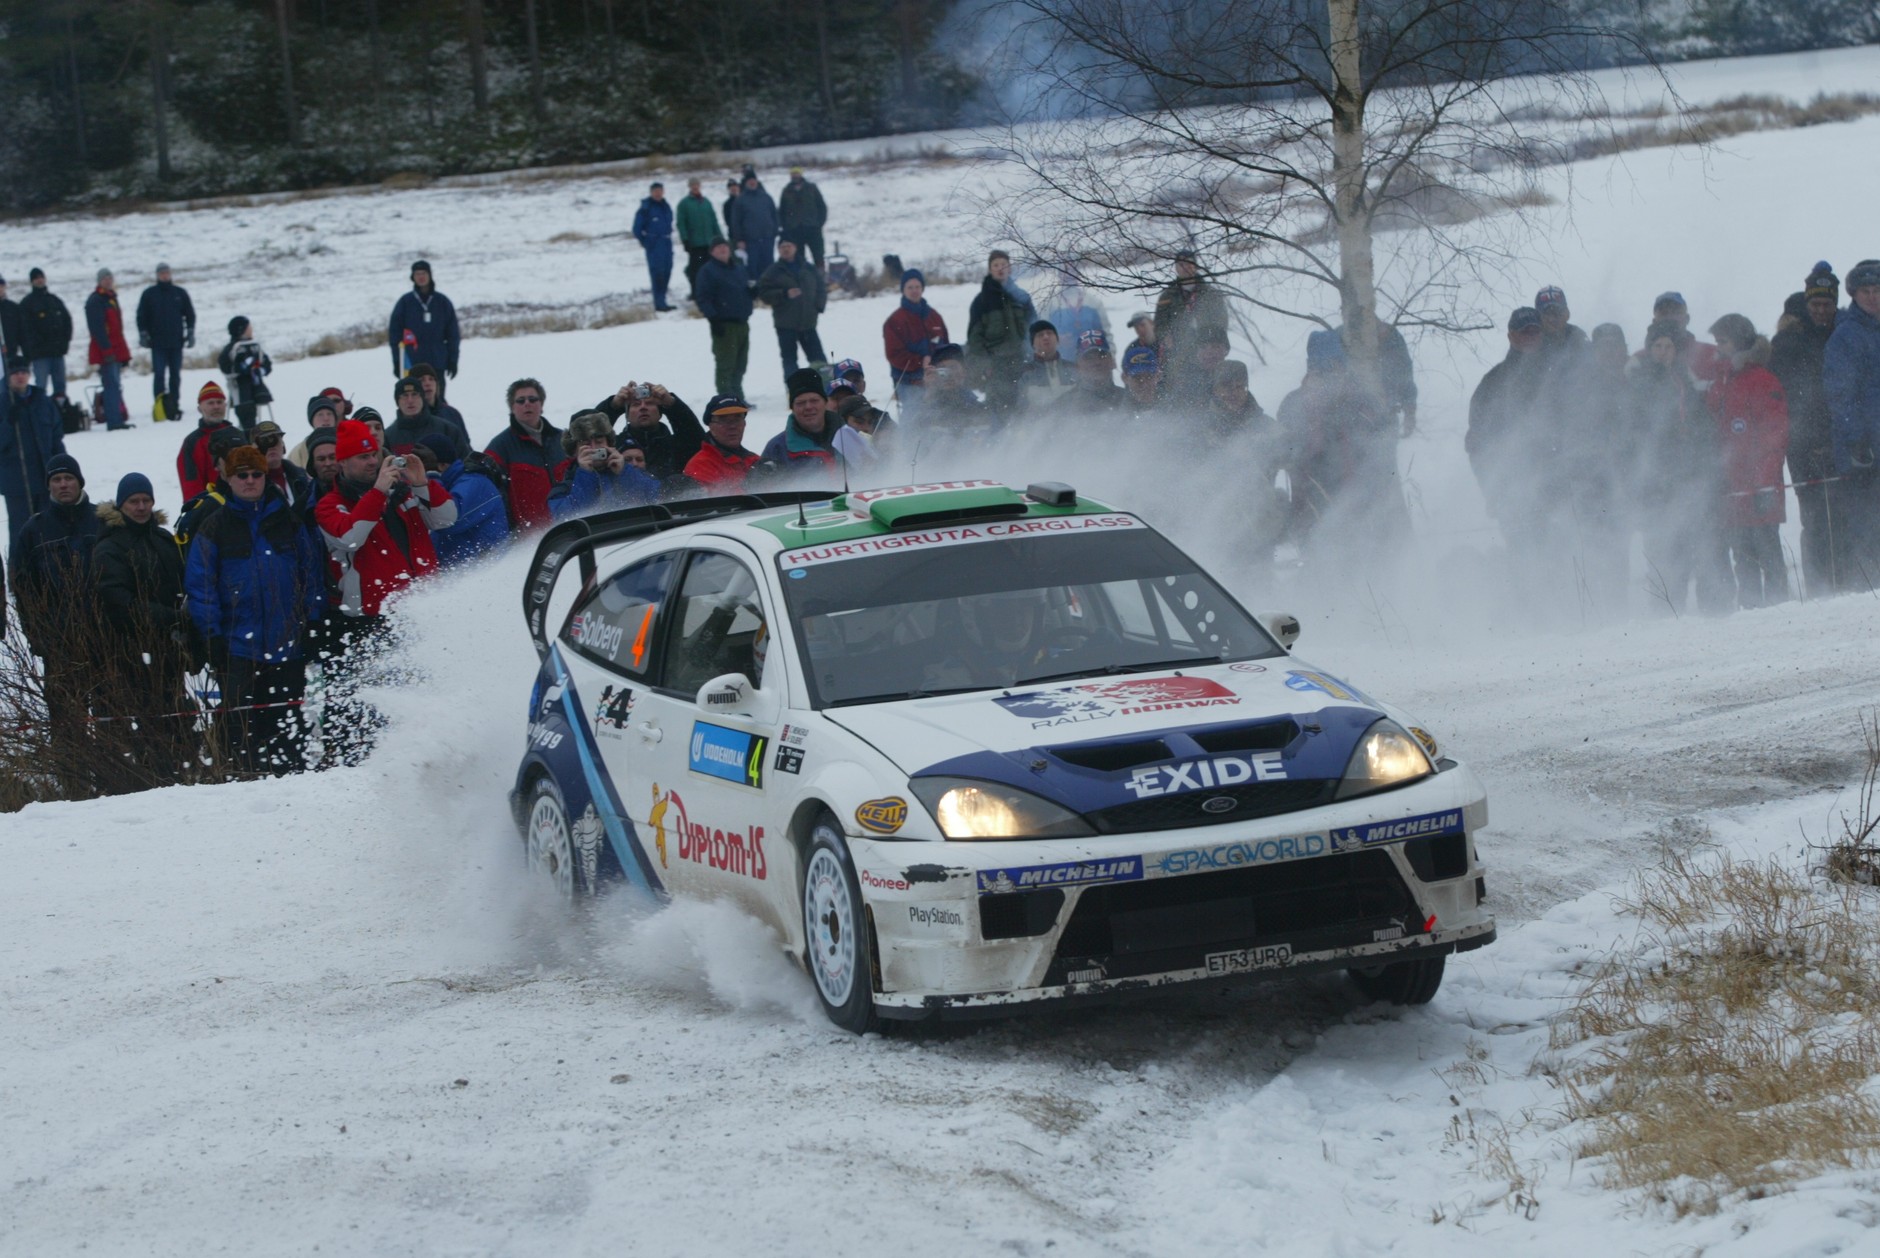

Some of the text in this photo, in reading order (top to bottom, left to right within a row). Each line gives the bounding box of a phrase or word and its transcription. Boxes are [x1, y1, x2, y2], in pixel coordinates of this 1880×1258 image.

[787, 516, 1134, 564] HURTIGRUTA CARGLASS
[578, 611, 624, 661] Solberg
[631, 604, 655, 668] 4
[707, 692, 737, 704] PUMA
[1031, 709, 1117, 730] RALLY
[703, 742, 746, 768] UDDEHOLM
[748, 738, 763, 788] 4
[1124, 751, 1288, 799] EXIDE
[860, 805, 907, 826] HELLA
[1366, 813, 1459, 841] MICHELIN
[1166, 834, 1325, 873] SPACEWORLD
[861, 869, 910, 891] Pioneer
[1019, 861, 1136, 885] MICHELIN
[909, 906, 961, 928] PlayStation
[1208, 946, 1290, 972] ET53 URO
[1067, 968, 1102, 984] PUMA
